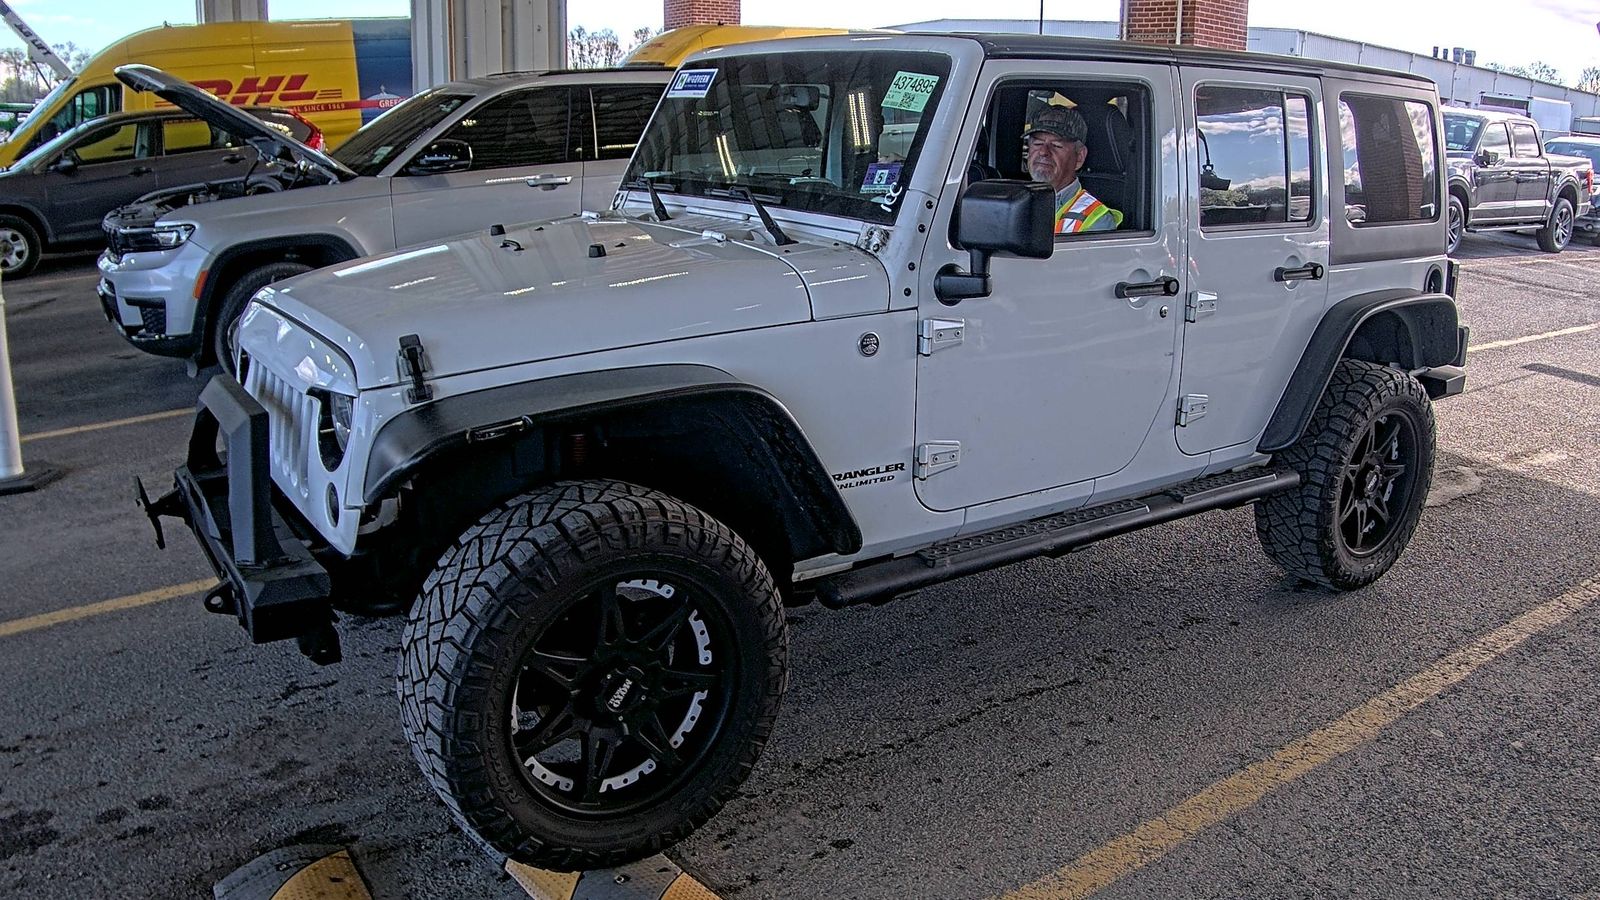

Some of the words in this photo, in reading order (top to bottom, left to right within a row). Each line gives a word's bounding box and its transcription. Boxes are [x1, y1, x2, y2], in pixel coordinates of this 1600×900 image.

[189, 74, 318, 105] DHL
[893, 75, 937, 94] 4374895
[876, 171, 885, 184] 5
[831, 462, 906, 482] RANGLER
[837, 475, 896, 490] NLIMITED
